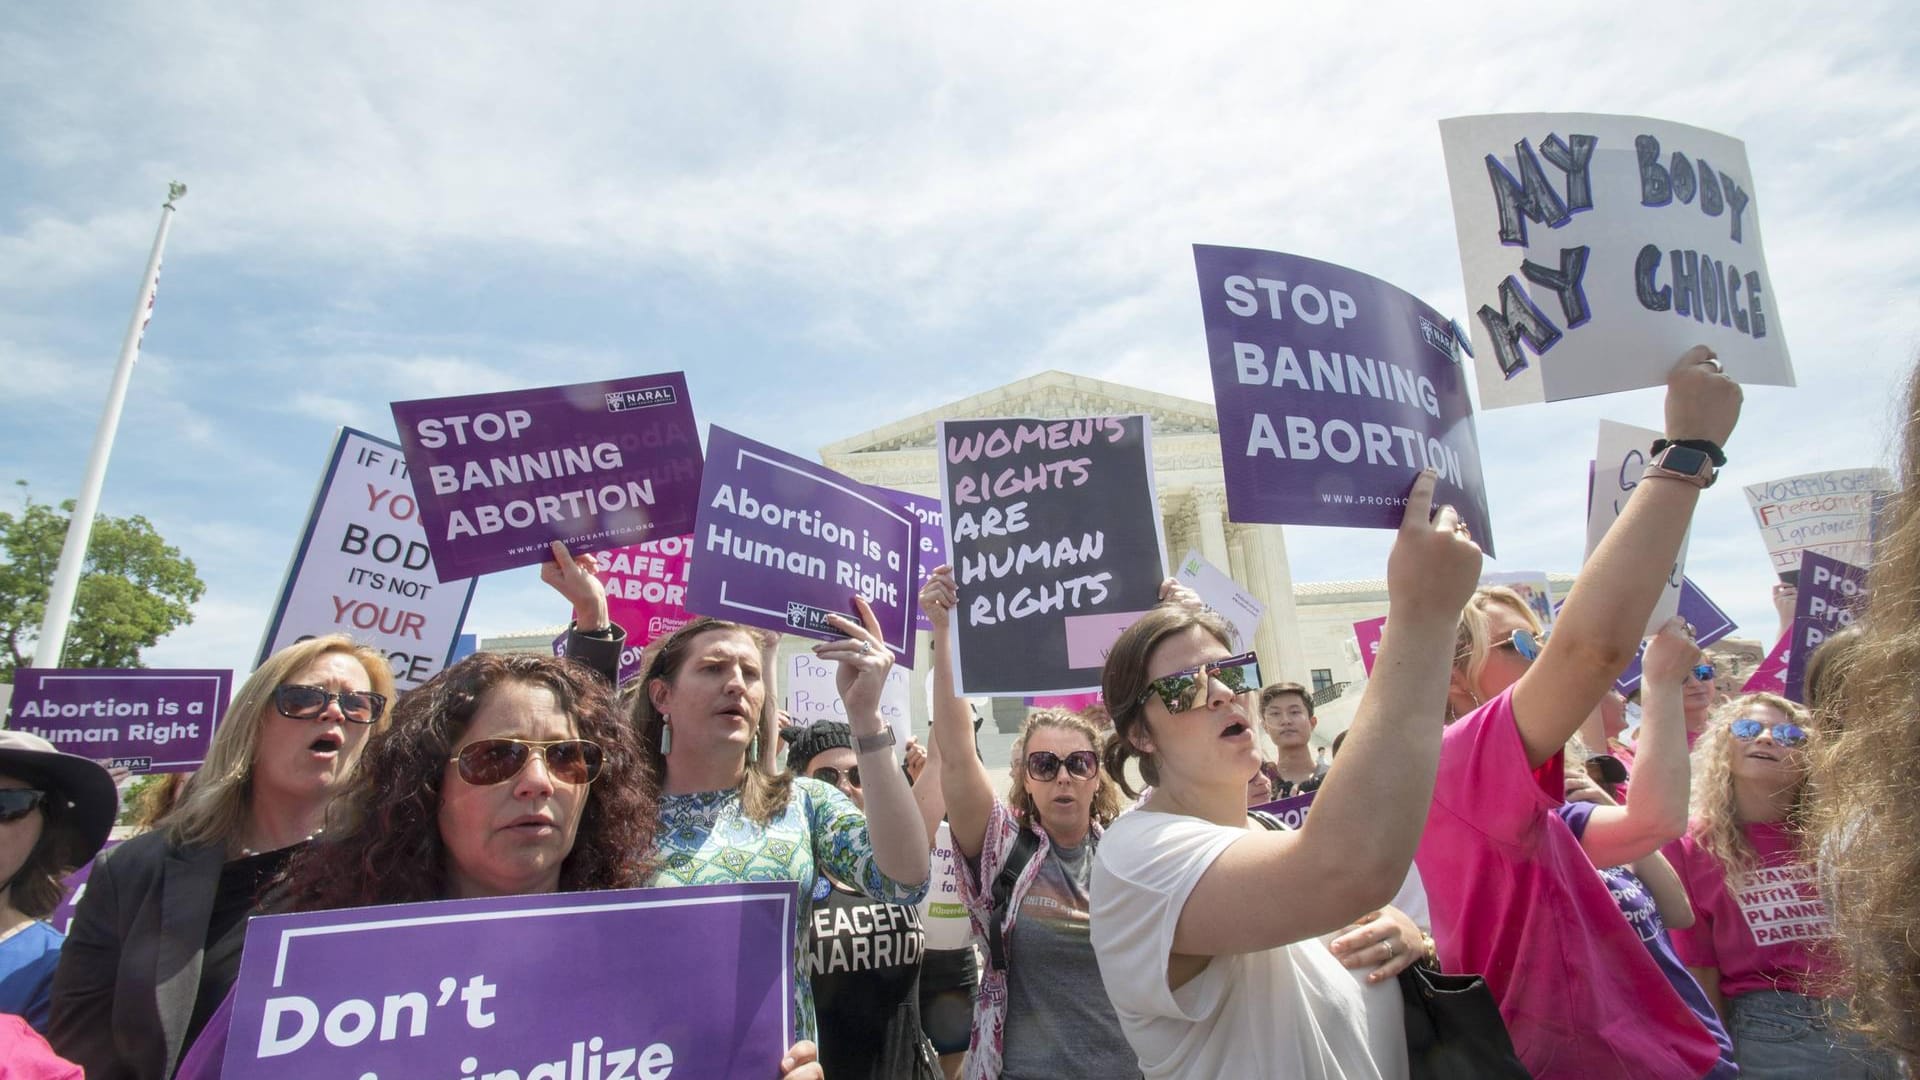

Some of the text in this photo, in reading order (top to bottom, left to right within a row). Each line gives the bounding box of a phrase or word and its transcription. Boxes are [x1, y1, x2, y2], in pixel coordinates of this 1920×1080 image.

[1484, 132, 1749, 248] MY BODY
[1224, 274, 1357, 329] STOP
[1477, 243, 1766, 381] MY CHOICE
[626, 389, 671, 403] NARAL
[1233, 341, 1441, 418] BANNING
[417, 408, 533, 449] STOP
[948, 416, 1125, 465] WOMEN'S
[1245, 412, 1463, 489] ABORTION
[357, 447, 383, 467] IF
[429, 442, 624, 496] BANNING
[954, 458, 1093, 505] RIGHTS
[445, 479, 657, 542] ABORTION
[710, 483, 856, 551] Abortion
[862, 529, 882, 557] is
[887, 551, 901, 573] a
[954, 501, 1029, 543] ARE
[508, 523, 655, 555] WWW.PRHOICEAMERICA.ORG
[962, 531, 1105, 585] HUMAN
[348, 568, 432, 600] IT'S NOT
[596, 551, 673, 583] SAFE,
[706, 524, 898, 609] Human Right
[605, 577, 688, 606] ABOR
[969, 572, 1112, 626] RIGHTS
[332, 595, 426, 640] YOUR
[20, 698, 204, 718] Abortion is a
[128, 722, 199, 744] Right
[1739, 887, 1795, 906] WITH
[810, 903, 925, 938] EACEFUL
[257, 973, 498, 1059] Don't
